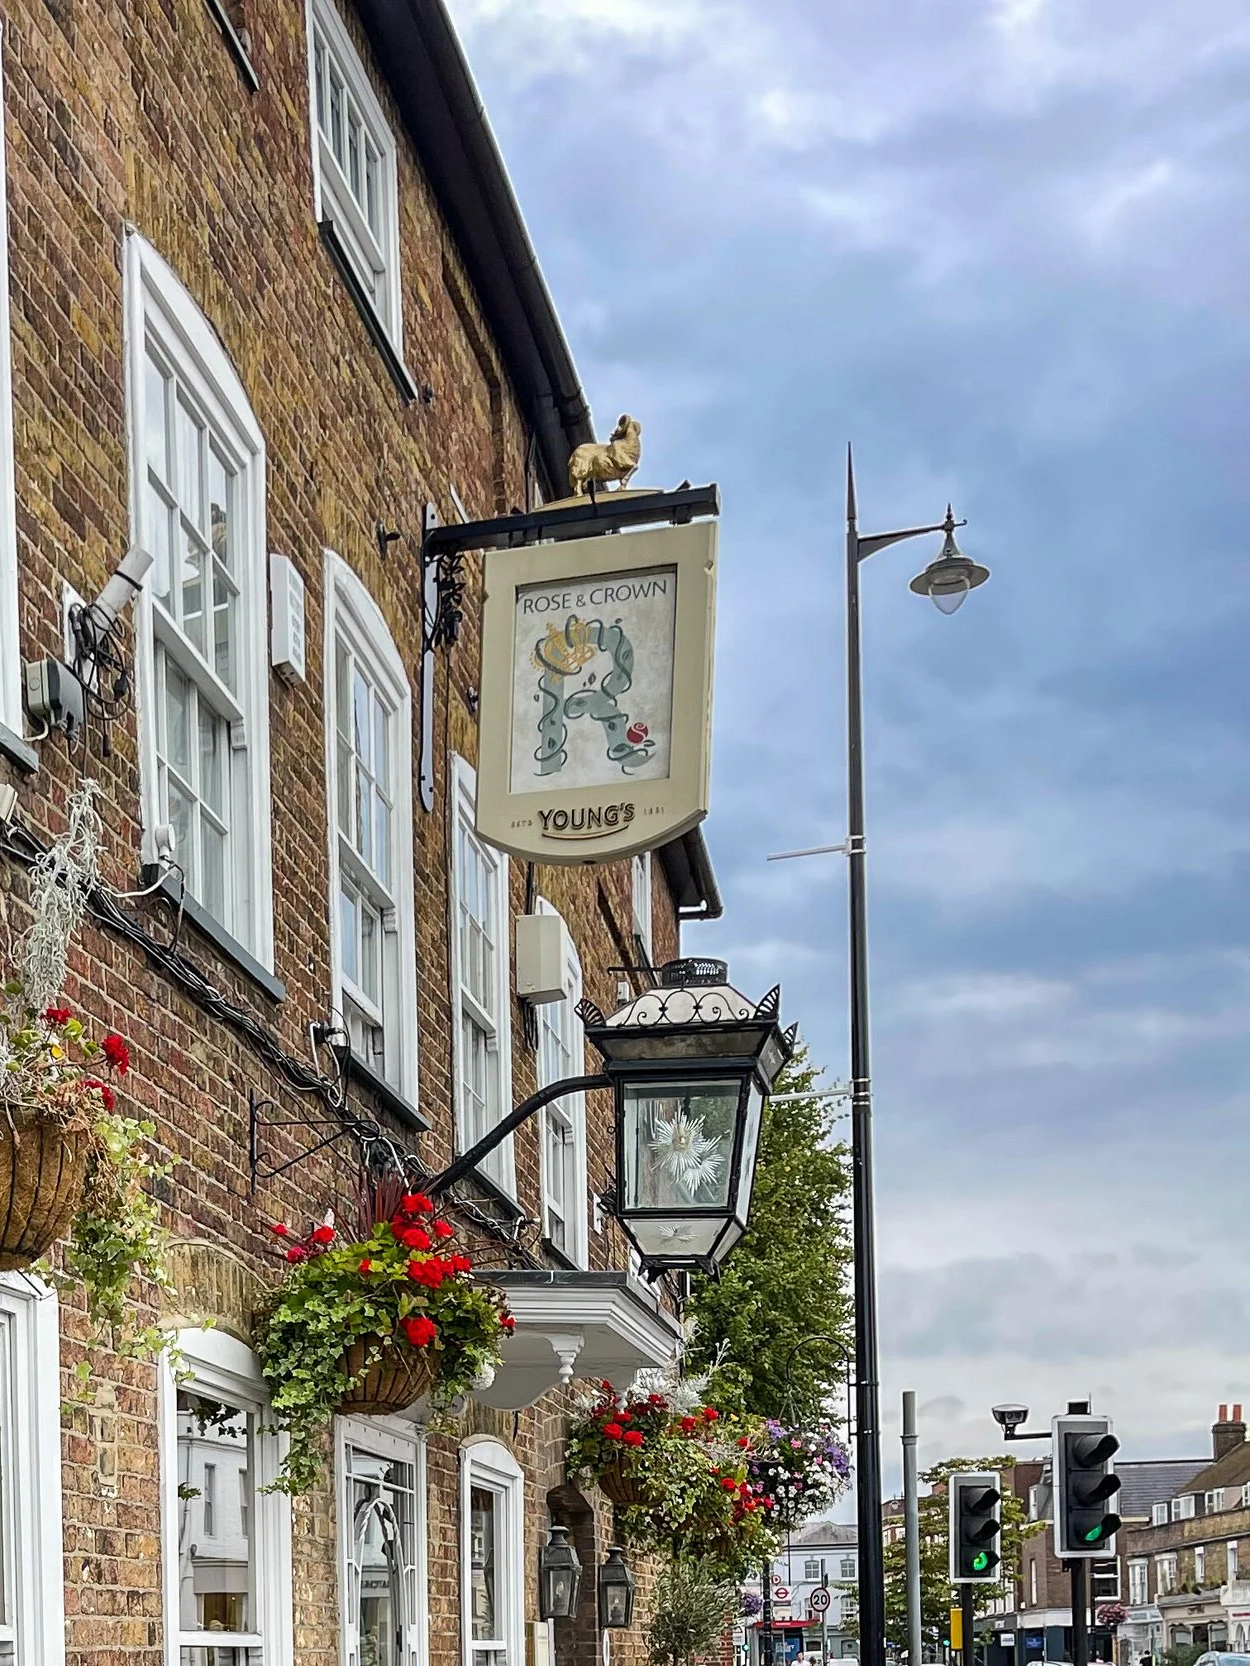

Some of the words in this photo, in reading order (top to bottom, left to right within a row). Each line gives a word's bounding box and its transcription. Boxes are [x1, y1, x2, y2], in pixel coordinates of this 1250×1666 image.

[523, 593, 573, 614] ROSE
[575, 594, 586, 608] &
[589, 580, 667, 605] CROWN
[538, 802, 635, 831] YOUNG'S
[813, 1594, 828, 1606] 20
